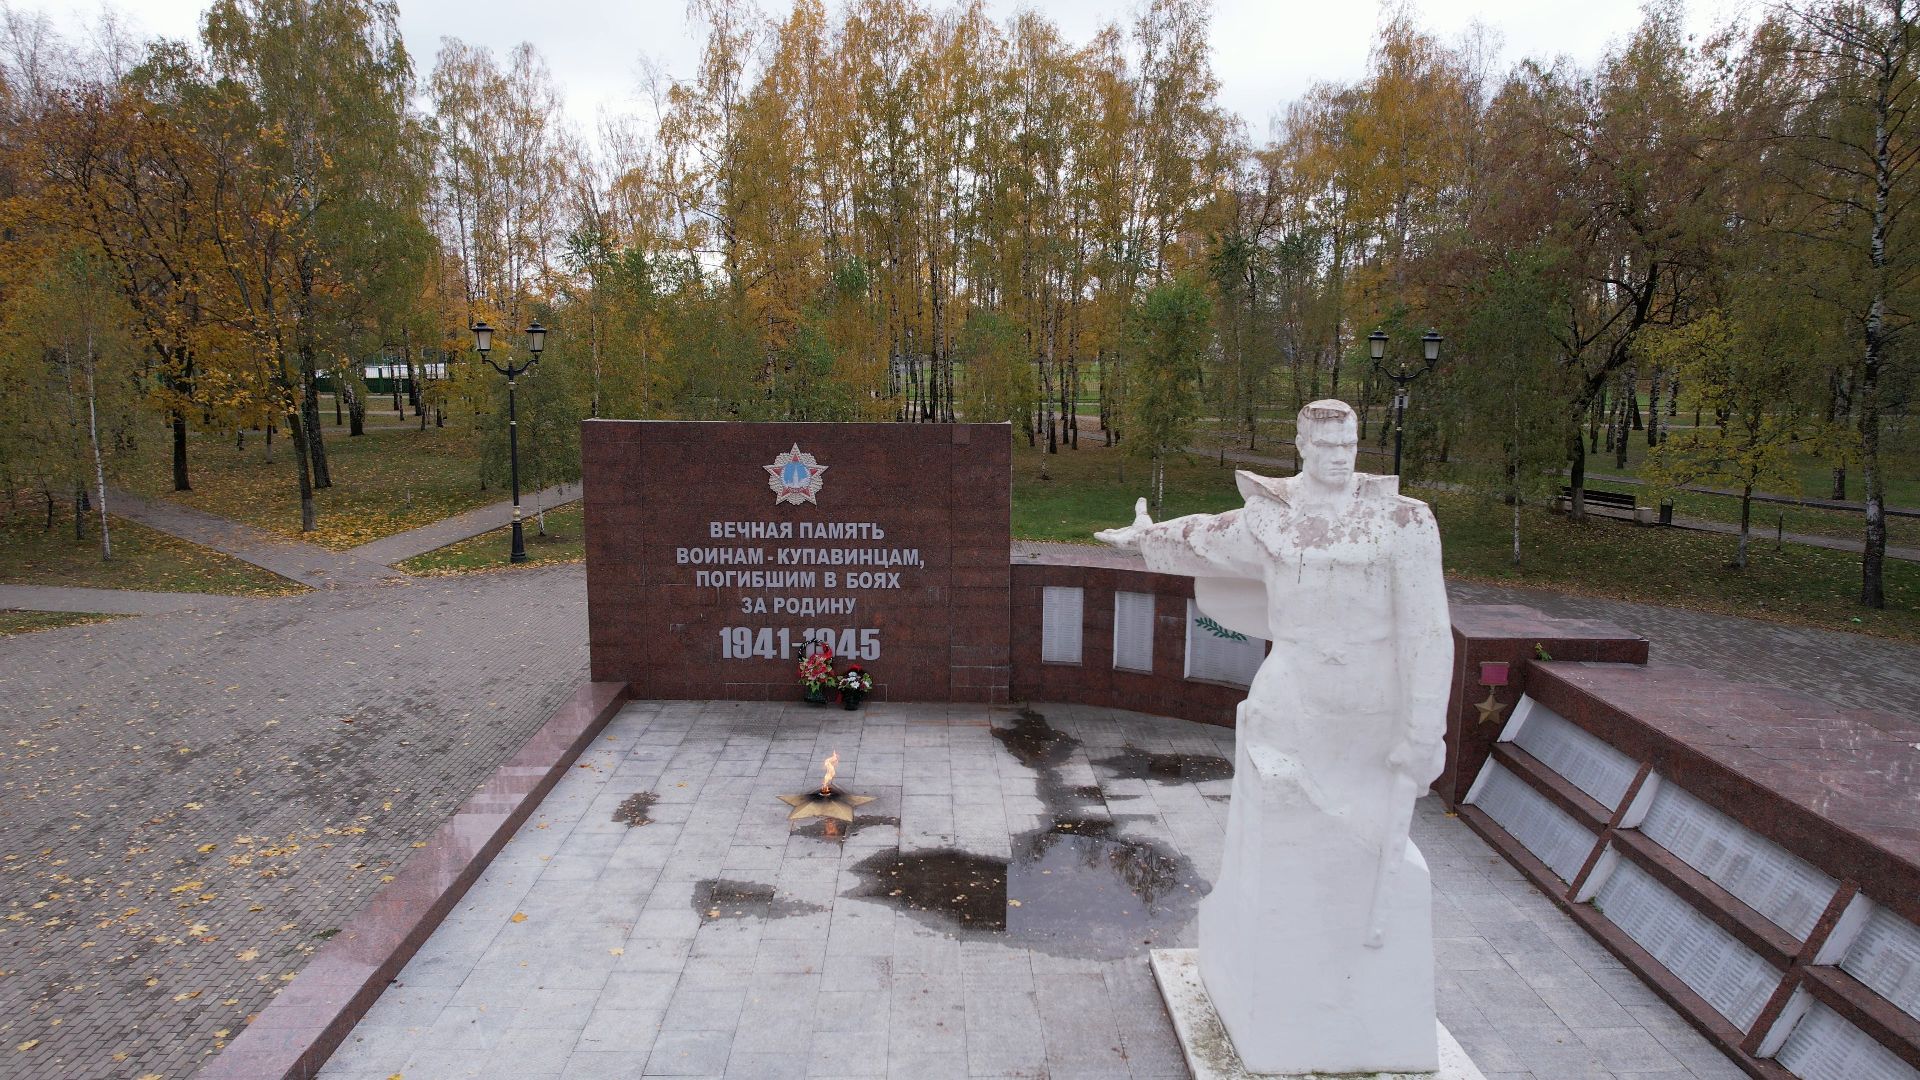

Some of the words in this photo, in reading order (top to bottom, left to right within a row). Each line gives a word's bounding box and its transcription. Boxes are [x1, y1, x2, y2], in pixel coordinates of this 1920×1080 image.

[710, 521, 793, 539] ВЕЧНАЯ
[799, 522, 885, 540] ПАМЯТЬ
[696, 570, 816, 588] ПОГИБШИМ
[824, 571, 837, 588] В
[846, 572, 901, 589] БОЯХ
[741, 597, 768, 614] ЗА
[773, 597, 856, 617] РОДИНУ
